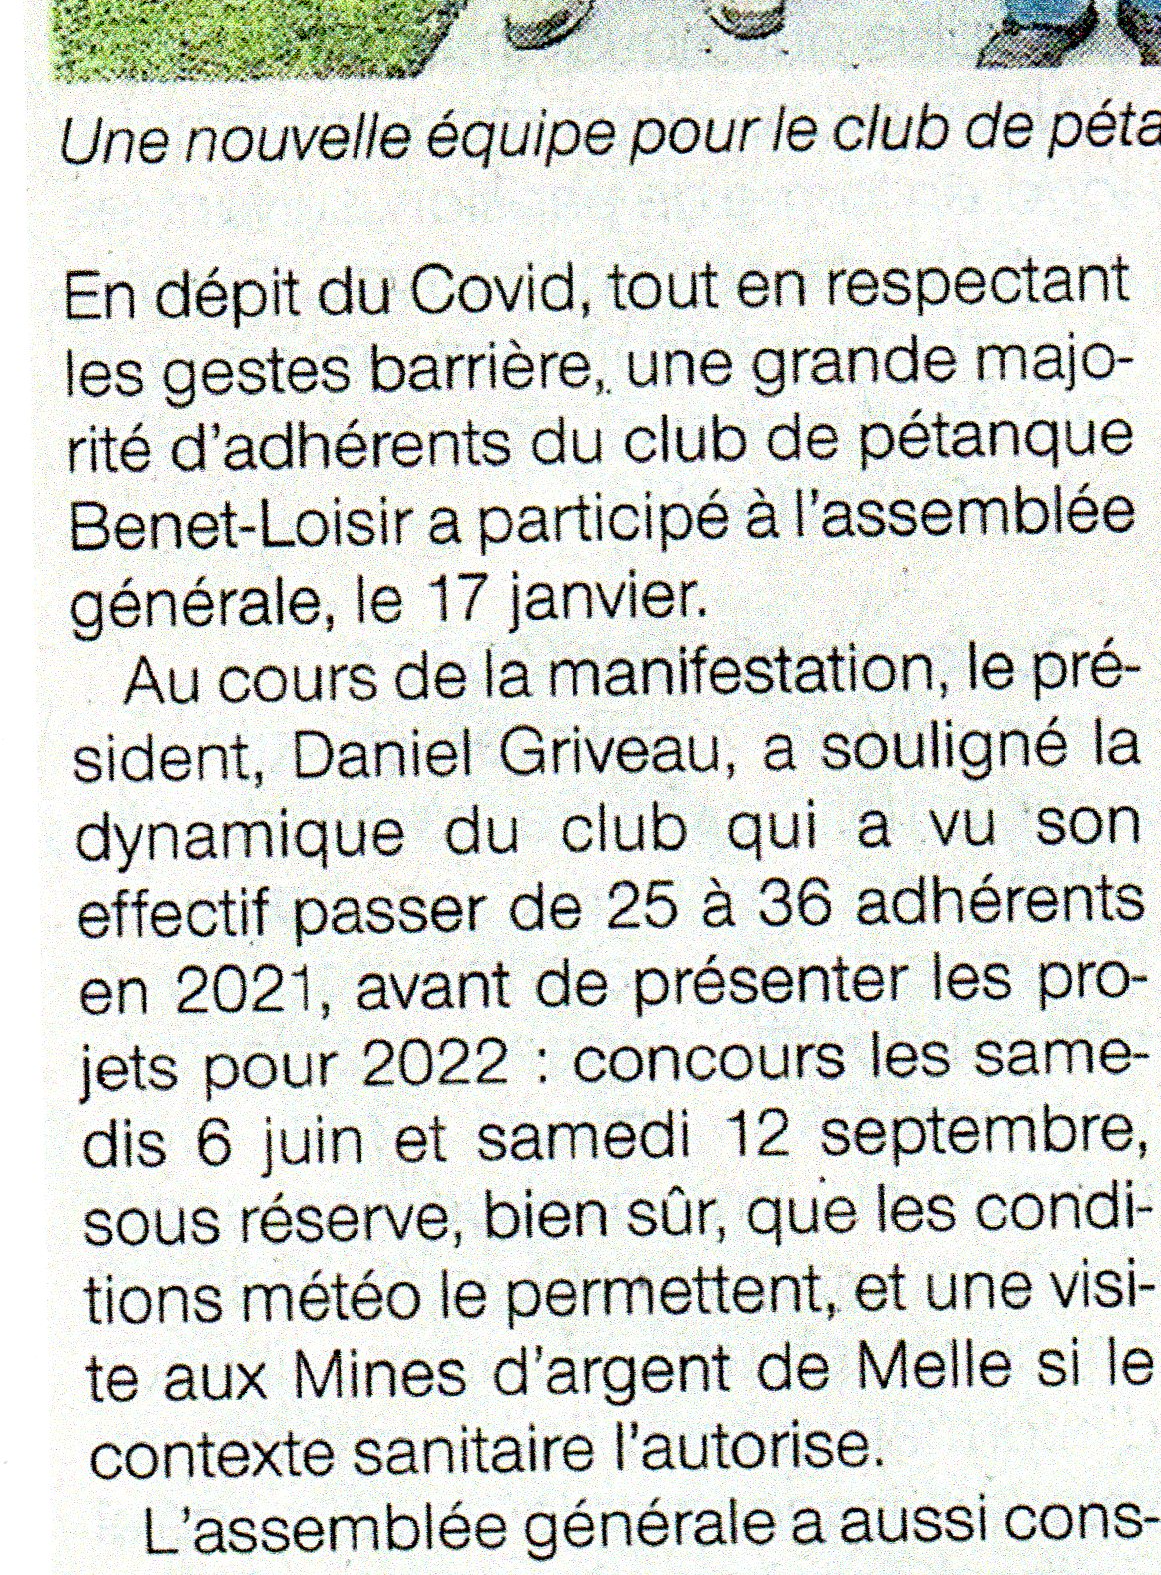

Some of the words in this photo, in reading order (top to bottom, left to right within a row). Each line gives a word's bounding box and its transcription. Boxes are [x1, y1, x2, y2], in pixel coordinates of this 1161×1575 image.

[61, 117, 170, 166] Une
[185, 112, 412, 163] nouvelle
[427, 109, 616, 169] équipe
[629, 116, 761, 165] pour
[772, 105, 818, 153] le
[833, 102, 950, 152] club
[965, 100, 1034, 150] de
[65, 269, 136, 320] En
[155, 266, 301, 329] dépit
[410, 261, 590, 318] Covid,
[607, 262, 719, 311] tout
[828, 255, 1130, 316] respectant
[162, 347, 351, 410] gestes
[370, 339, 604, 394] barrière,
[752, 334, 957, 398] grande
[977, 331, 1133, 392] majo-
[68, 422, 151, 473] rité
[624, 414, 747, 464] club
[860, 408, 1134, 471] pétanque
[70, 495, 414, 552] Benet-Loisir
[478, 488, 729, 556] participé
[70, 575, 335, 642] générale,
[430, 571, 489, 622] 17
[508, 568, 706, 634] janvier.
[123, 654, 199, 705] Au
[218, 663, 378, 704] cours
[549, 642, 948, 699] manifestation,
[1033, 636, 1141, 701] pré-
[73, 733, 263, 788] sident,
[294, 727, 471, 780] Daniel
[500, 724, 735, 778] Griveau,
[822, 715, 1068, 782] souligné
[76, 807, 405, 874] dynamique
[562, 800, 688, 853] club
[1037, 805, 1140, 846] son
[77, 885, 270, 940] effectif
[294, 894, 487, 947] passer
[607, 879, 679, 930] 25
[759, 876, 832, 928] 36
[856, 872, 1145, 926] adhérents
[177, 963, 330, 1019] 2021,
[356, 961, 510, 1011] avant
[634, 953, 909, 1018] présenter
[1039, 960, 1148, 1011] pro-
[78, 1043, 178, 1105] jets
[205, 1051, 338, 1102] pour
[363, 1036, 508, 1087] 2022
[573, 1042, 846, 1084] concours
[975, 1037, 1149, 1078] same-
[197, 1117, 232, 1167] 6
[261, 1115, 362, 1179] juin
[478, 1109, 689, 1162] samedi
[729, 1107, 789, 1157] 12
[821, 1103, 1147, 1167] septembre,
[84, 1206, 221, 1247] sous
[241, 1192, 462, 1248] réserve,
[485, 1188, 608, 1240] bien
[627, 1185, 726, 1243] sûr,
[747, 1193, 857, 1247] que
[975, 1179, 1153, 1232] condi-
[83, 1274, 223, 1325] tions
[243, 1268, 421, 1322] météo
[507, 1265, 836, 1330] permettent,
[1049, 1257, 1156, 1309] visi-
[164, 1362, 267, 1402] aux
[295, 1348, 467, 1399] Mines
[858, 1338, 1012, 1390] Melle
[90, 1431, 335, 1481] contexte
[354, 1423, 594, 1477] sanitaire
[524, 1497, 776, 1562] générale
[840, 1493, 987, 1545] aussi
[1004, 1501, 1160, 1542] cons-
